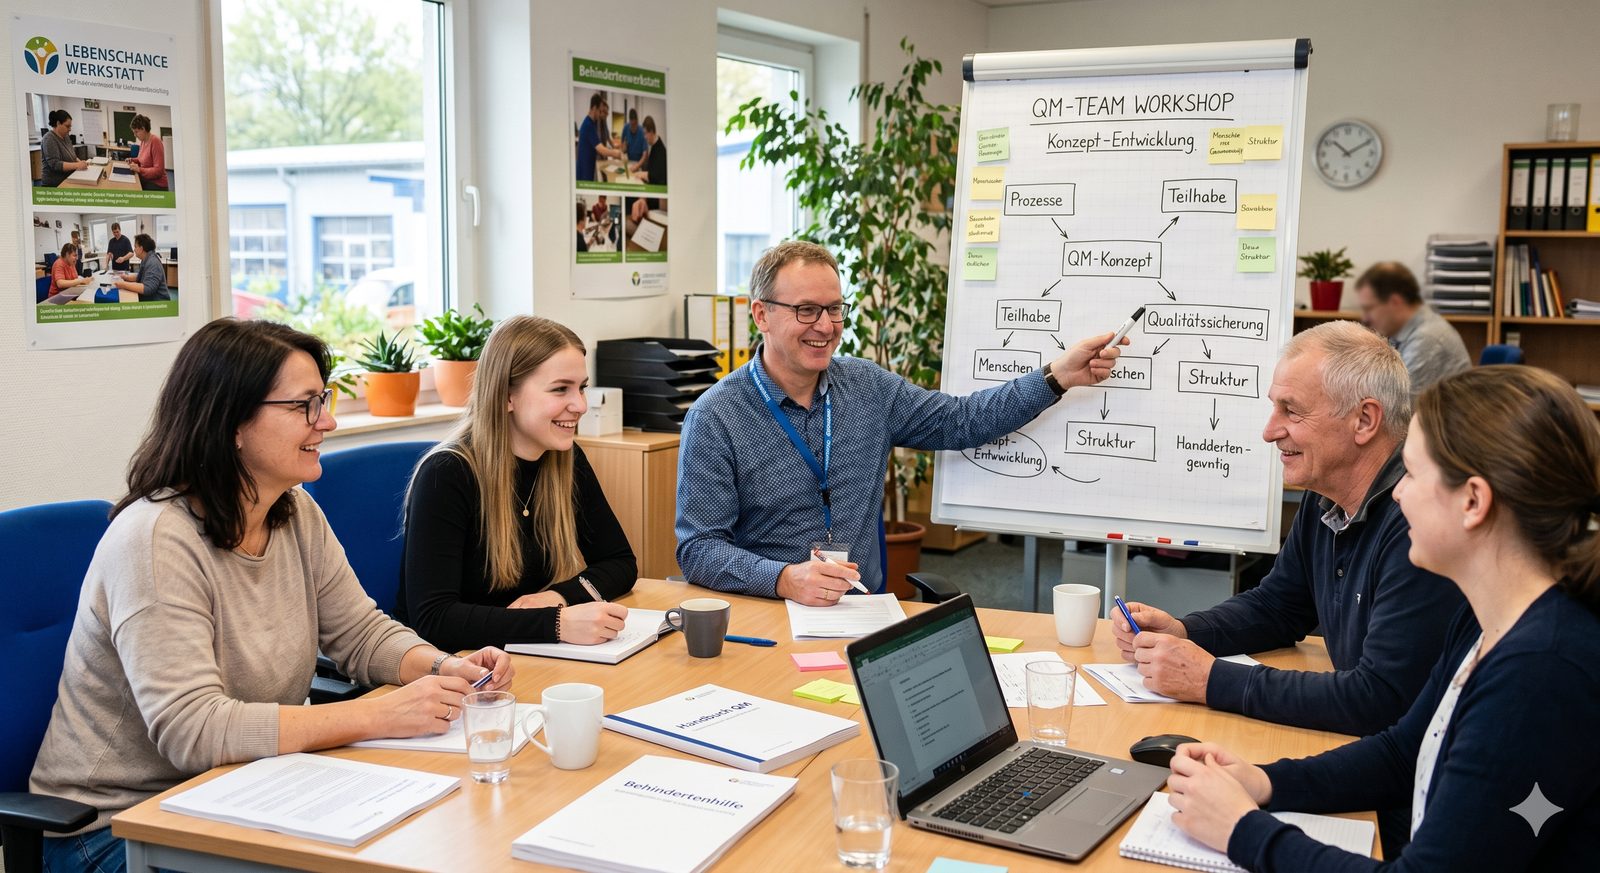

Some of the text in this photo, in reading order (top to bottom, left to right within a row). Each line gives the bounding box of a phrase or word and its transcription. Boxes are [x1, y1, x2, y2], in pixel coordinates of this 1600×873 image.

[64, 43, 169, 69] LEBENSCHANCE
[65, 60, 145, 82] WERKSTATT
[578, 64, 661, 89] Behindertenwerkstatt
[1032, 91, 1236, 118] QM-TEAM WORKSHOP
[1010, 191, 1064, 208] Prozesse
[1167, 187, 1228, 205] Teilhabe
[1067, 249, 1153, 272] QM-Konzept
[1001, 306, 1051, 324] Teilhabe
[1147, 310, 1264, 337] Qualitätssicherung
[978, 357, 1034, 374] Menschen
[1110, 365, 1146, 380] schen
[1188, 369, 1249, 388] Struktur
[1076, 429, 1136, 450] Struktur
[1176, 434, 1252, 455] Handderten-
[624, 779, 744, 810] Behindertenhilfe
